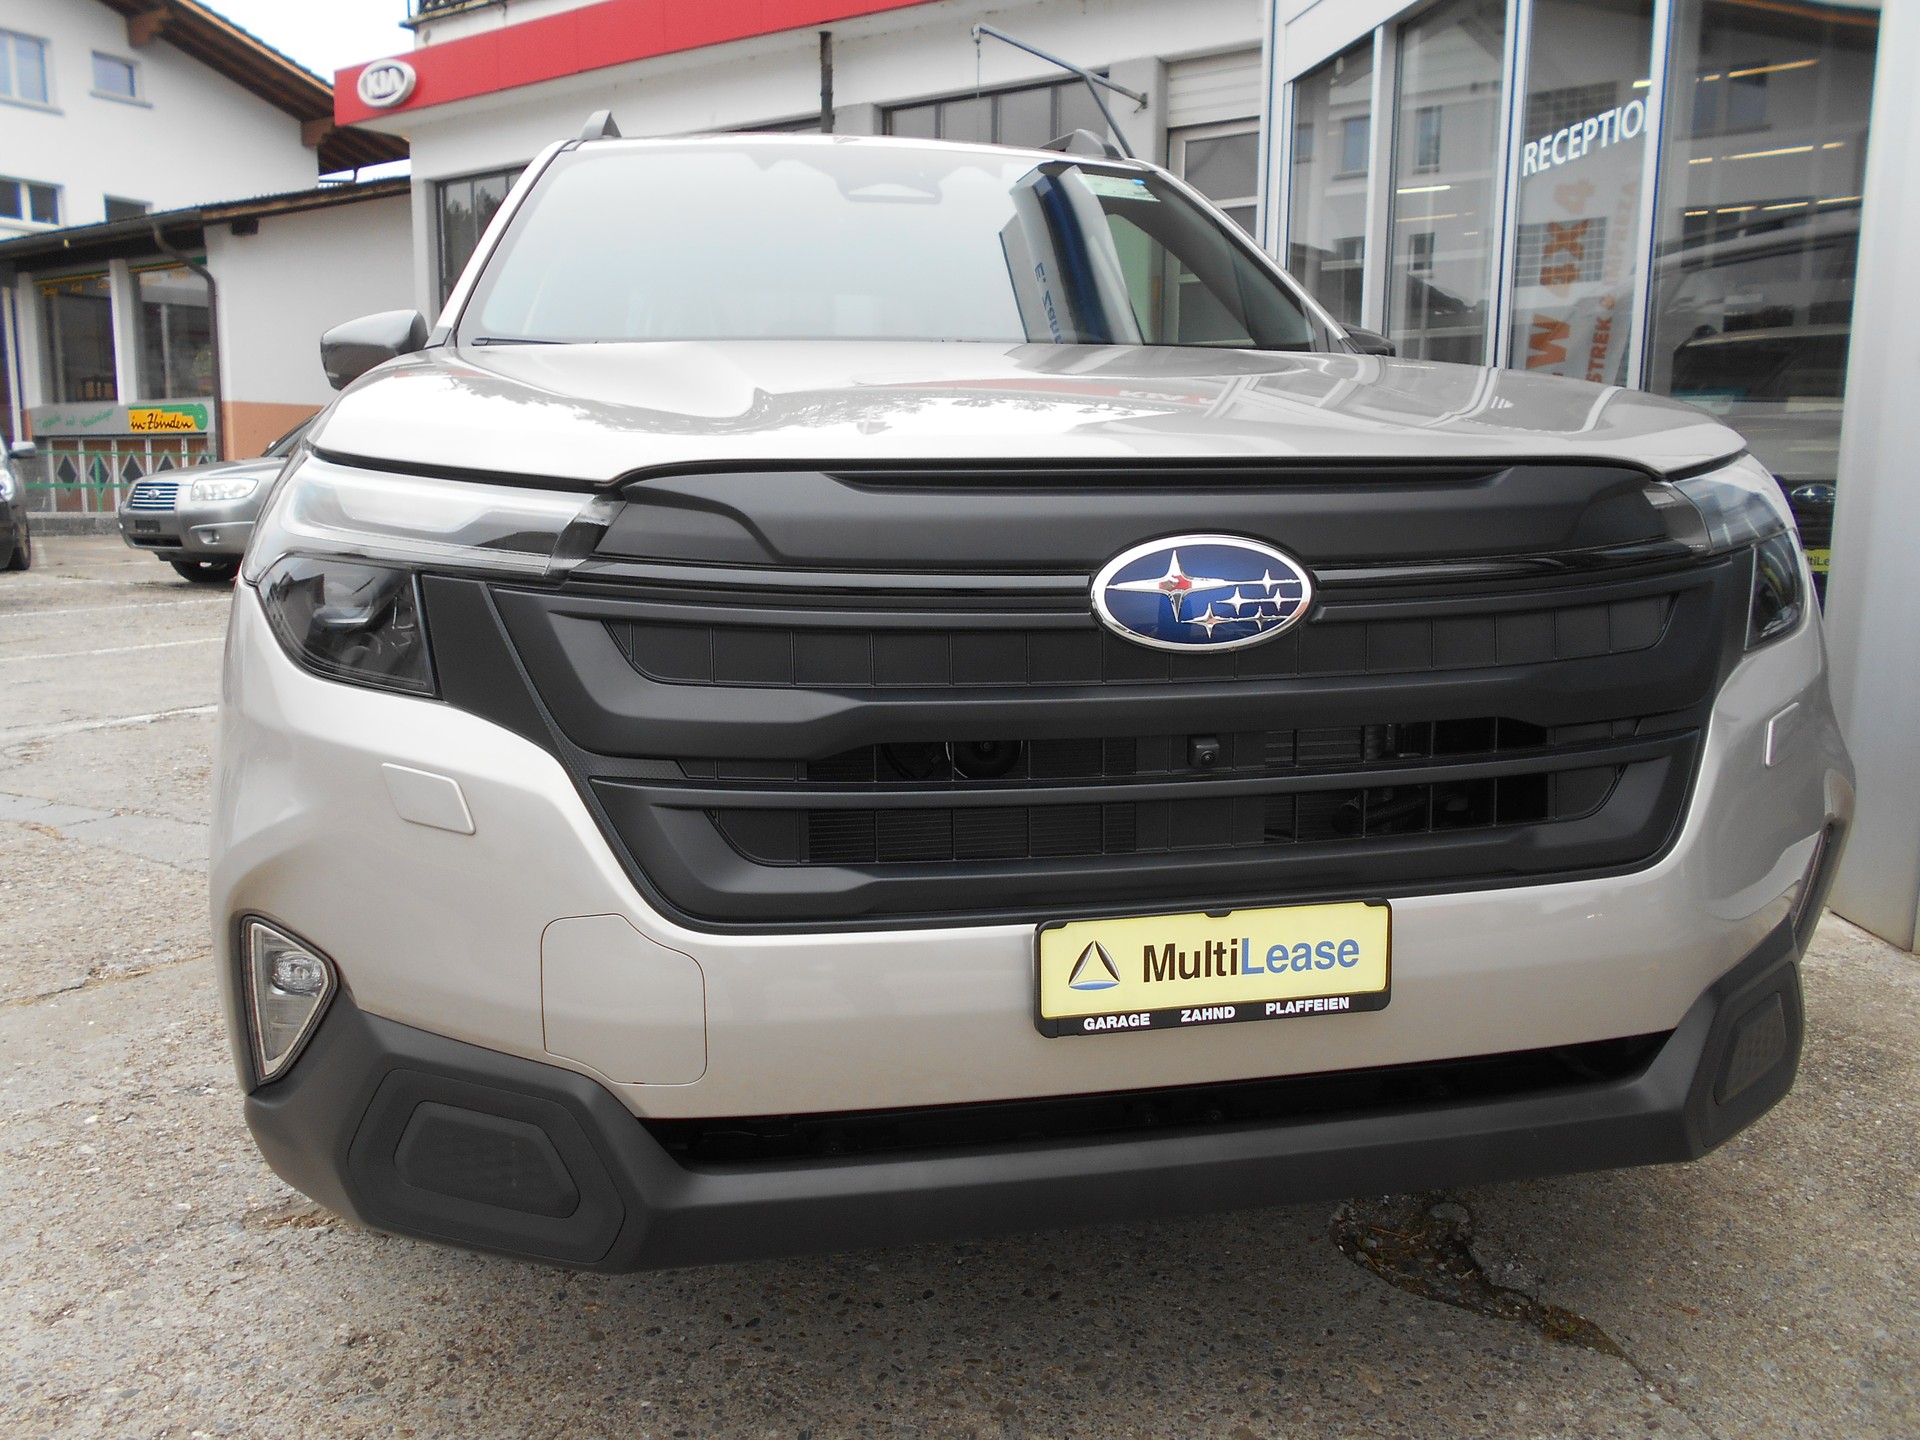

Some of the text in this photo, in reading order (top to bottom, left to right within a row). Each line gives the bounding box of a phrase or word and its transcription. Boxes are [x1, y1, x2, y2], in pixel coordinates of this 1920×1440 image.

[366, 68, 403, 98] KIA
[1143, 937, 1360, 983] MultiLease
[1083, 996, 1350, 1031] GARAGE ZAHND PLAFFEIEN
